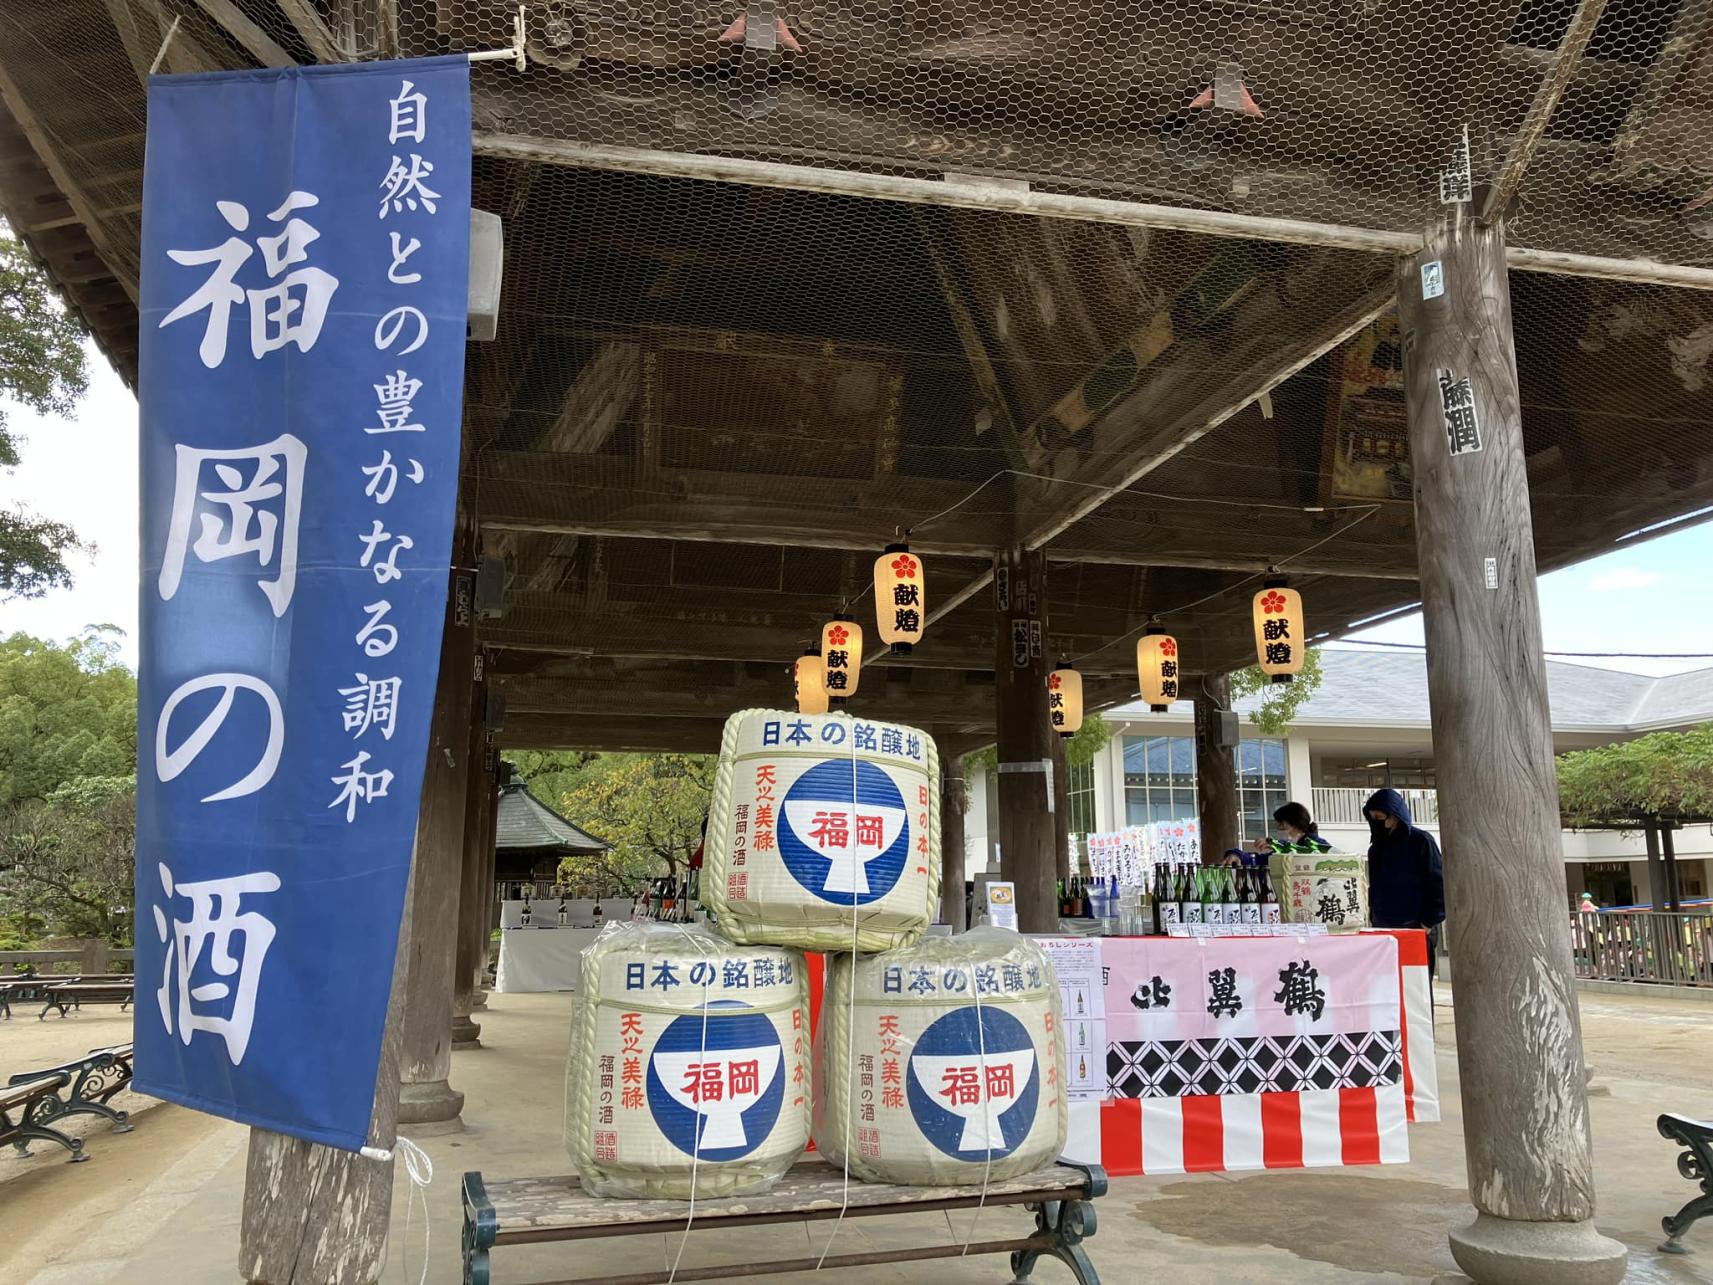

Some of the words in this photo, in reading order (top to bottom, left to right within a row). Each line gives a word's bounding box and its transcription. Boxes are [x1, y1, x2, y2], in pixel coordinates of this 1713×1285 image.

[328, 80, 441, 823] 自然との豊かなる調和
[153, 191, 338, 1065] 福岡の酒
[893, 583, 920, 633] 献燈
[1262, 618, 1292, 665] 献燈
[826, 649, 849, 690] 献燈
[763, 719, 921, 760] 日本の銘醸地
[732, 804, 750, 866] 福岡の酒
[808, 811, 884, 850] 福岡
[1315, 893, 1346, 926] 鶴
[625, 957, 794, 991] 日本の銘醸地
[883, 964, 1042, 995] 日本の銘醸地
[1130, 959, 1326, 1023] 比翼鶴
[599, 1055, 615, 1124] 福岡の酒
[680, 1058, 760, 1104] 福岡
[858, 1054, 875, 1122] 福岡の酒
[939, 1063, 1015, 1106] 福岡
